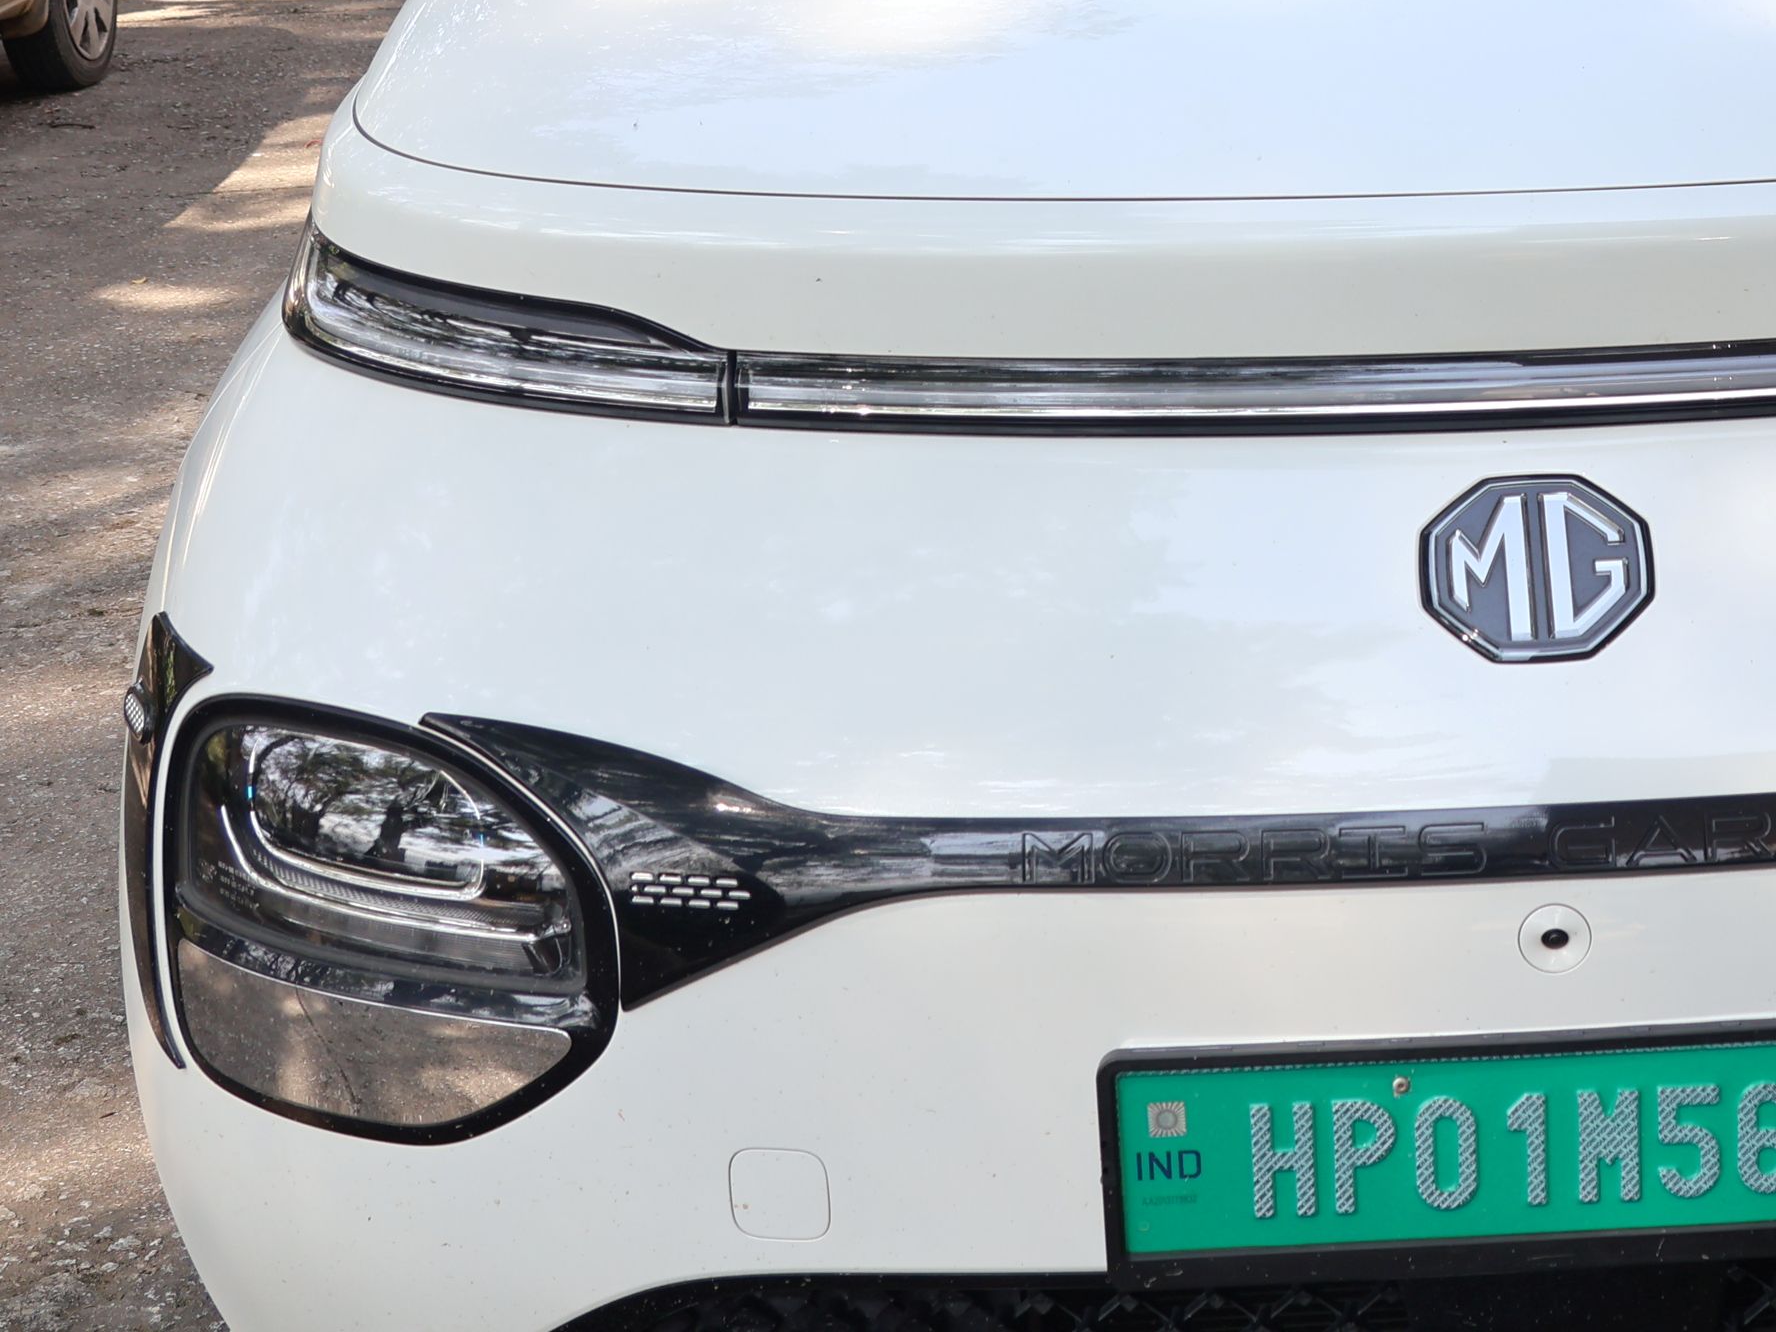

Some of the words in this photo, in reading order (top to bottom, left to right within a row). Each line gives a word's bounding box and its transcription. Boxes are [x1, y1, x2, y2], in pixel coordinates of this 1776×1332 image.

[1447, 492, 1629, 642] MG
[1019, 820, 1489, 888] MORRIS
[1136, 1149, 1202, 1181] IND
